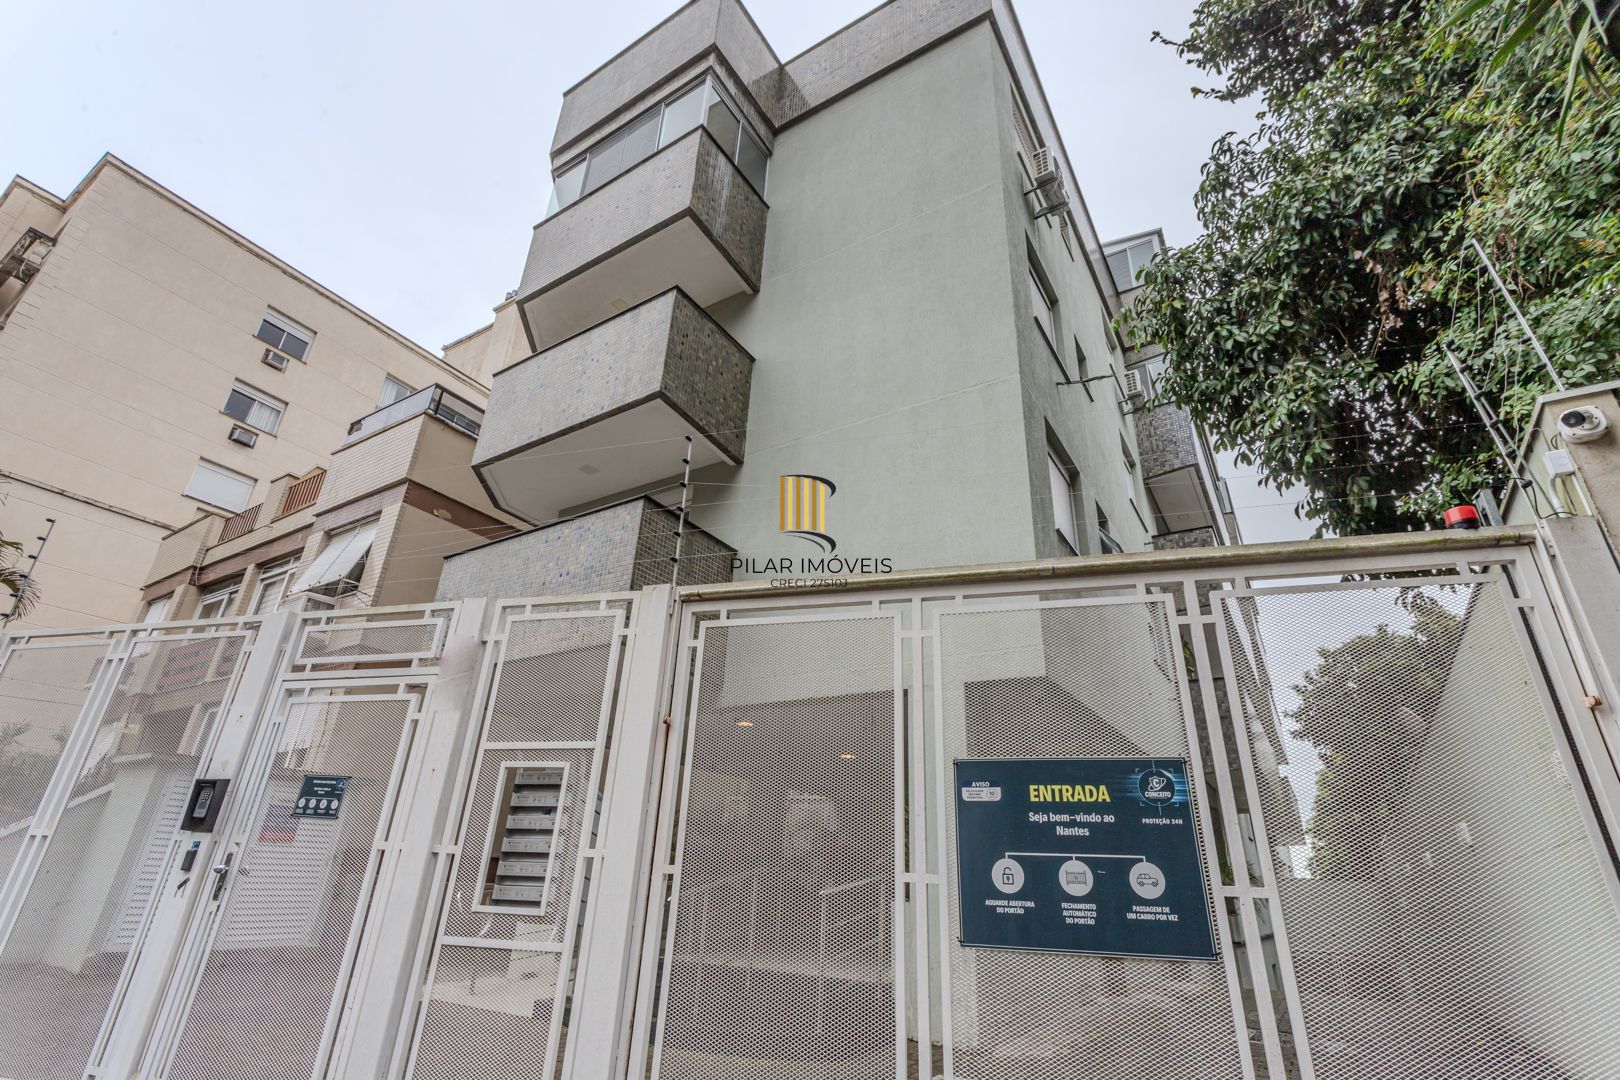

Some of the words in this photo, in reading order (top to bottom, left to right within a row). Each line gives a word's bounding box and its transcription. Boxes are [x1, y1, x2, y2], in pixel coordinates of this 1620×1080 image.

[1029, 784, 1111, 802] ENTRADA
[1028, 811, 1048, 823] Seja
[1049, 812, 1102, 823] bem-vindo
[1103, 814, 1115, 823] ao
[1142, 817, 1170, 826] PROTEÇÃO
[1055, 825, 1090, 836] Nantes
[985, 899, 1009, 907] AGUARDE
[1009, 900, 1035, 908] ABERTURA
[1061, 902, 1097, 910] FECHAMENTO
[1004, 906, 1025, 915] PORTÃO
[1062, 909, 1097, 918] AUTOMÁTICO
[1132, 905, 1162, 913] PASSAGEM
[1074, 917, 1095, 925] PORTÃO
[1126, 912, 1137, 920] UM
[1168, 914, 1179, 922] VEZ
